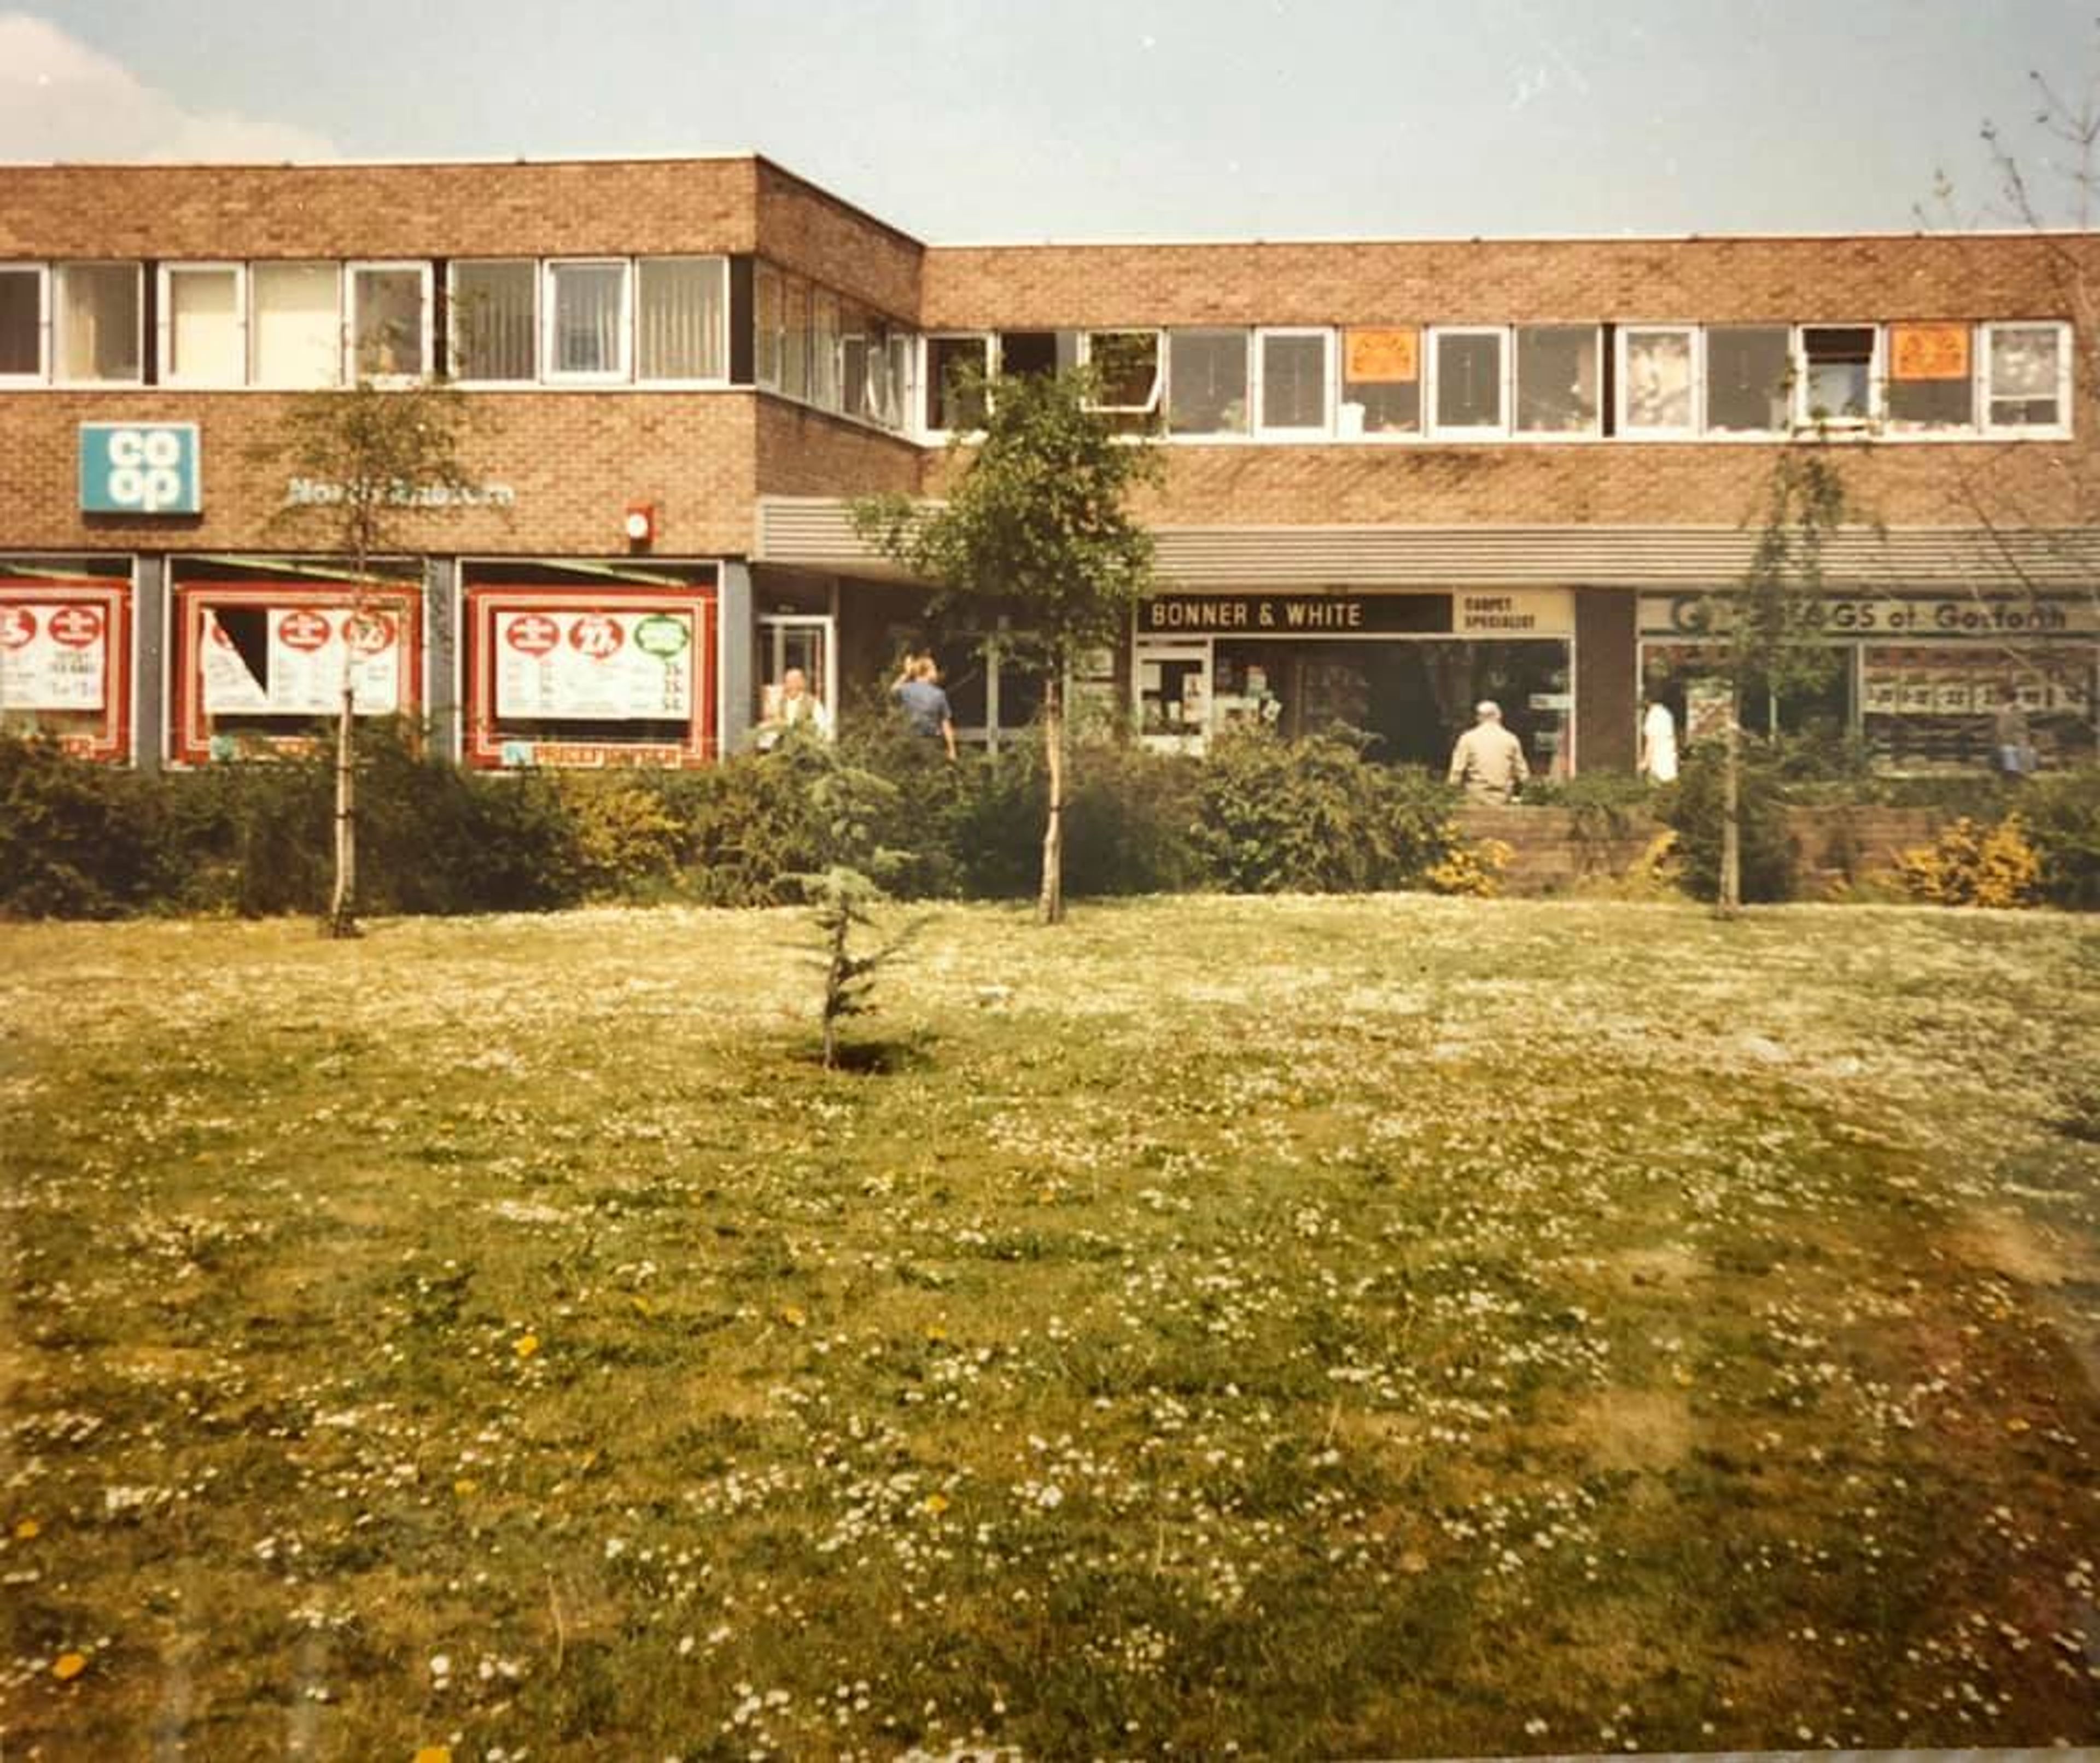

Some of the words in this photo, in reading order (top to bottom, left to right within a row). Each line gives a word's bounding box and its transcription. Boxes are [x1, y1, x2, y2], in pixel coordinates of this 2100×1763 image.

[1151, 602, 1247, 627] BONNER
[1258, 602, 1275, 627] &
[1286, 602, 1363, 627] WHITE
